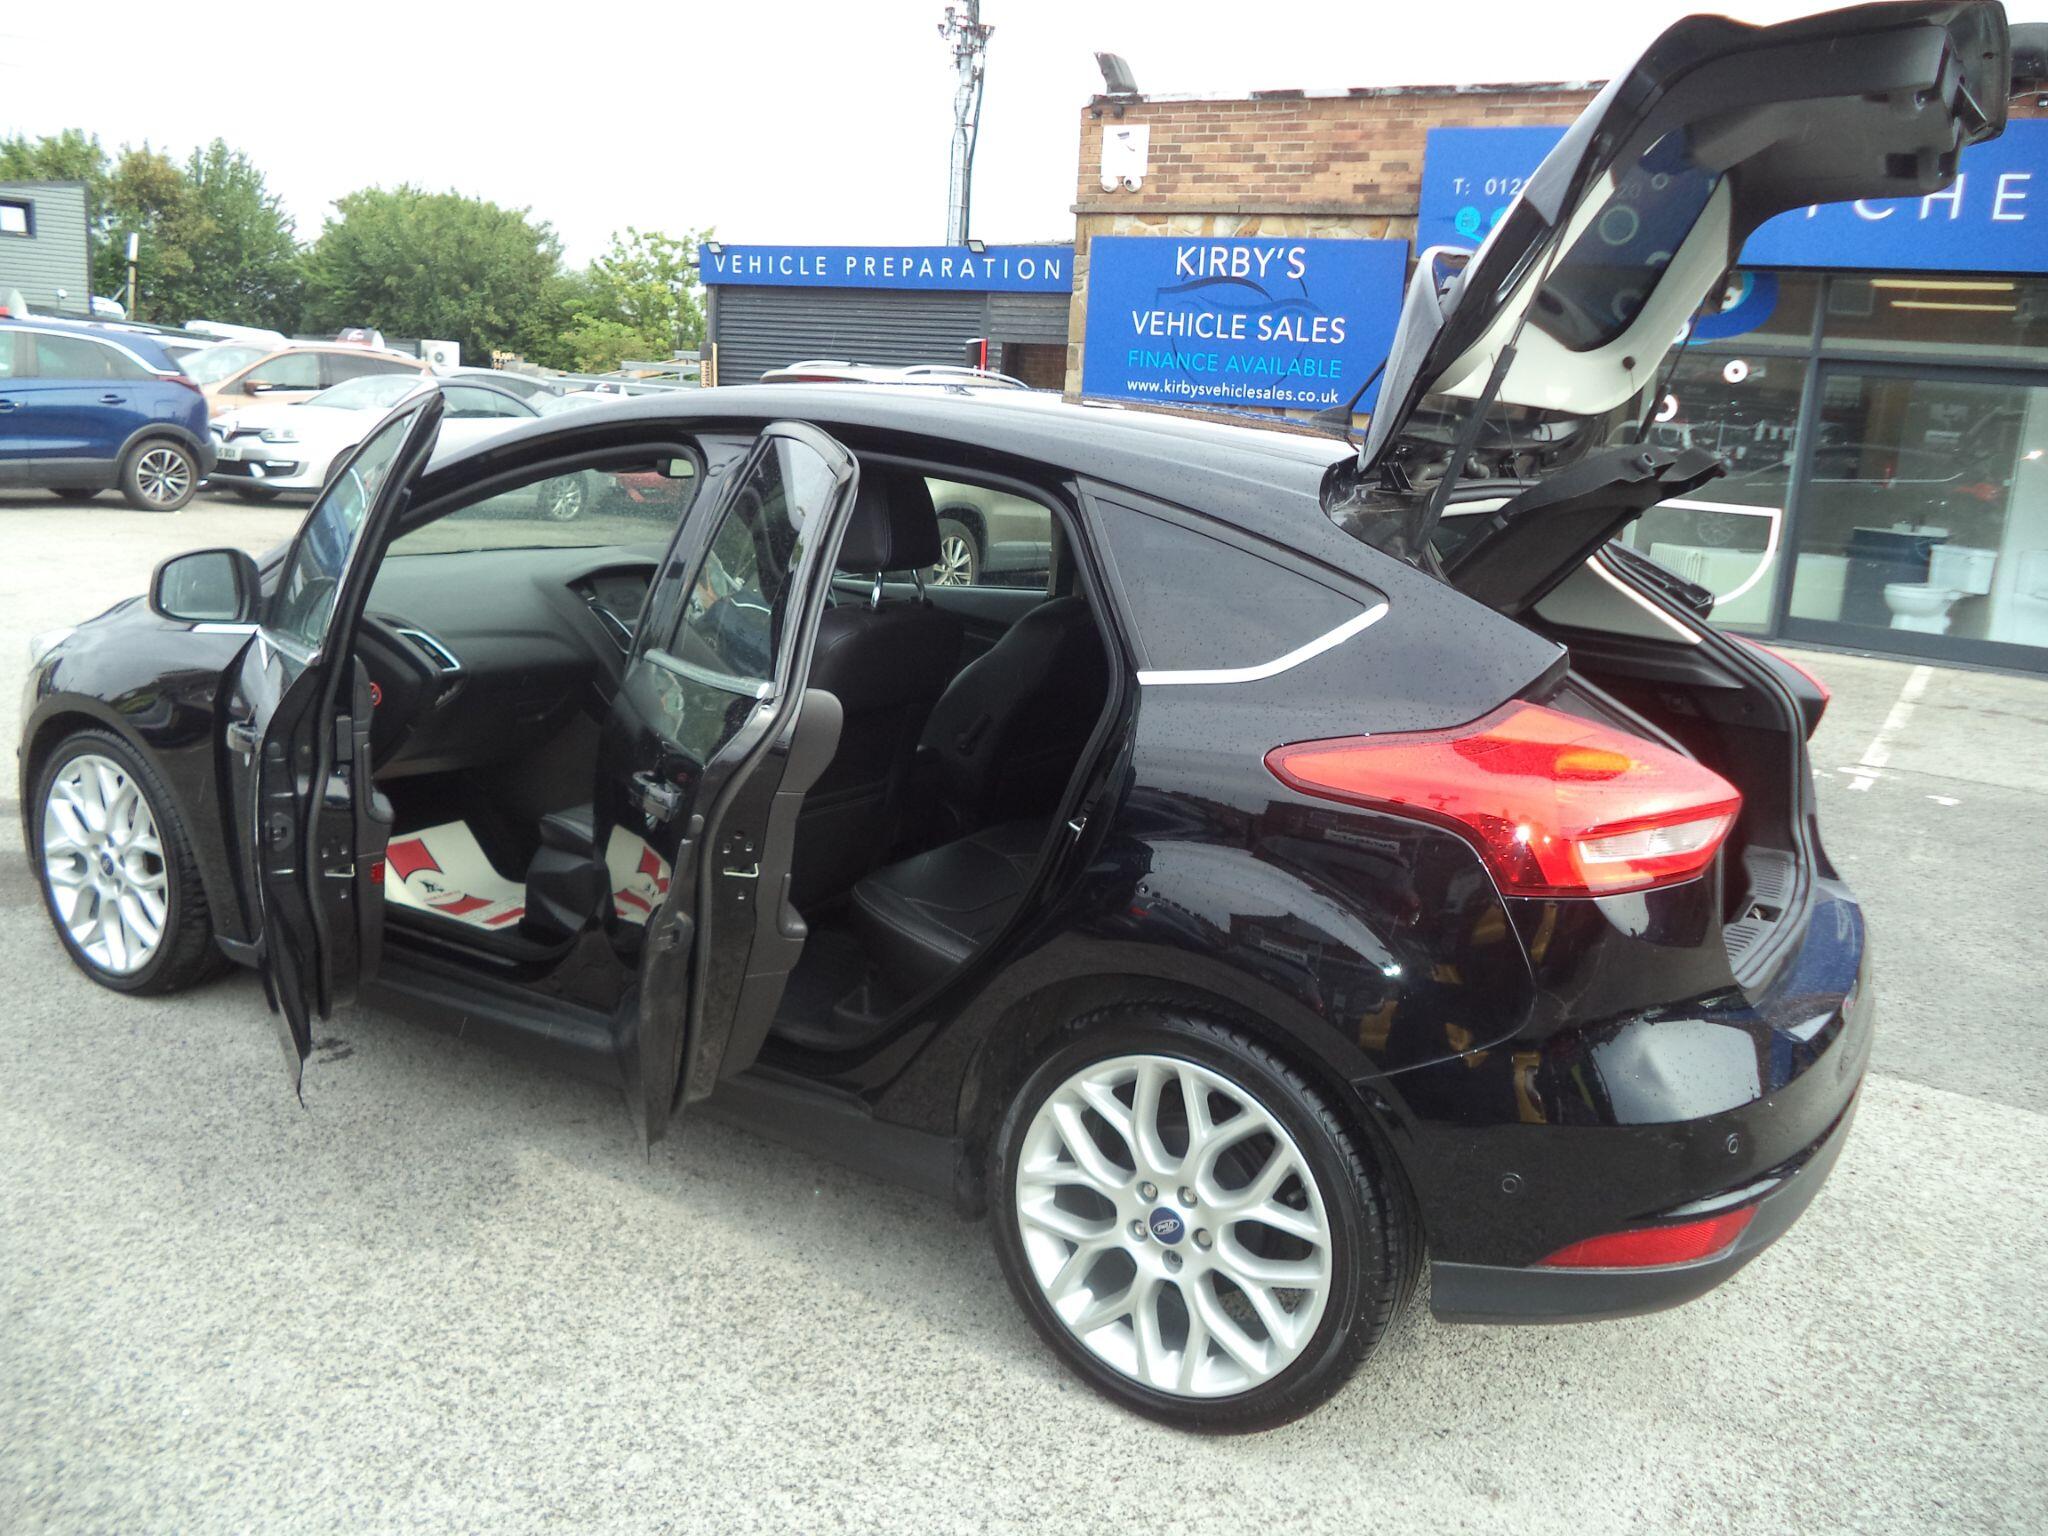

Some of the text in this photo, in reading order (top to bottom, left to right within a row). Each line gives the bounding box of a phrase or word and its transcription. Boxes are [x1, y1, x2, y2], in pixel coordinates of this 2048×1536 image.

[1484, 177, 1530, 196] 012
[1807, 173, 2032, 221] HE
[714, 255, 1060, 280] VEHICLE PREPARATION
[1175, 246, 1306, 279] KIRBY'S
[1132, 310, 1346, 344] VEHICLE SALES
[1128, 350, 1343, 379] FINANCE AVAILABLE
[1126, 379, 1339, 404] www.kirbysvehiclesales.co.uk
